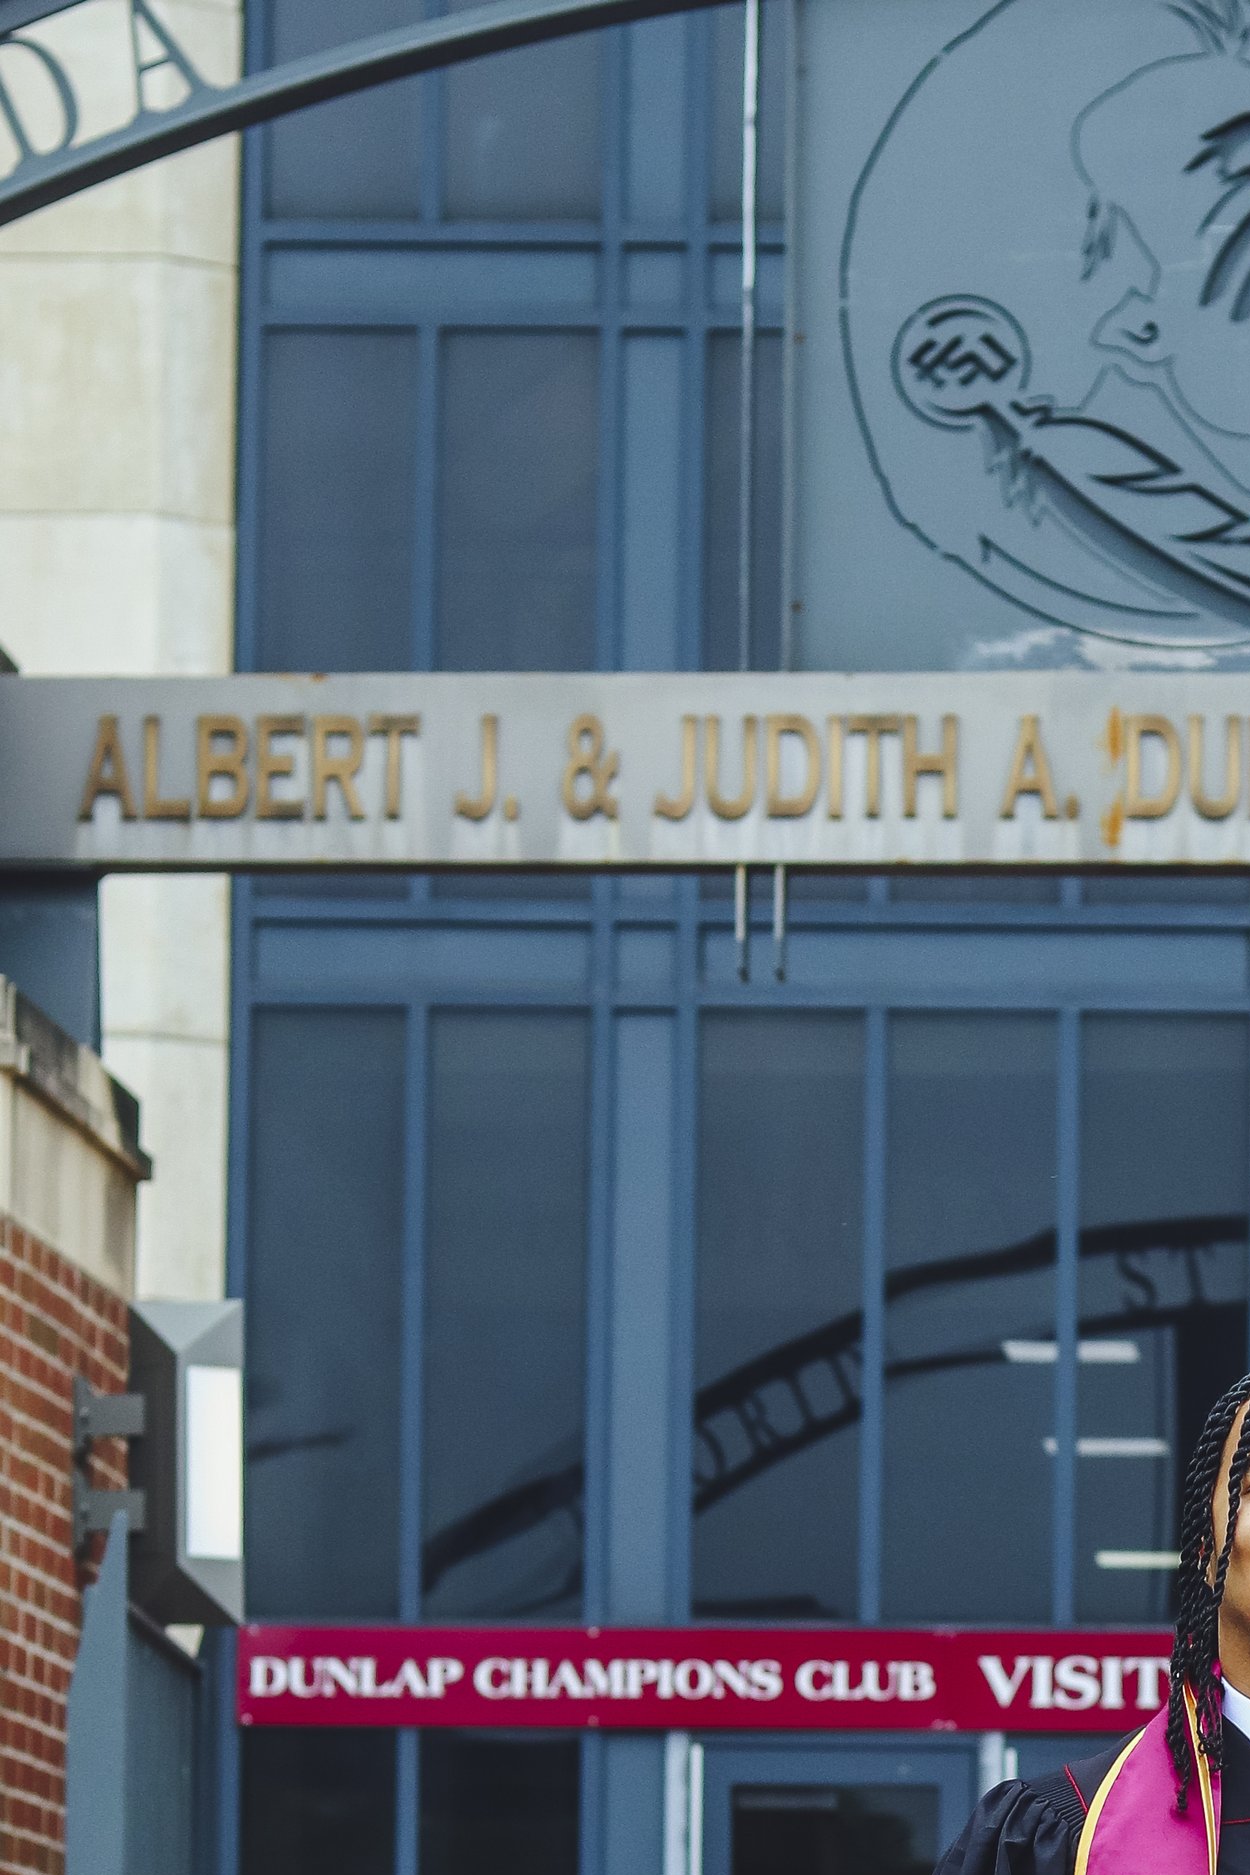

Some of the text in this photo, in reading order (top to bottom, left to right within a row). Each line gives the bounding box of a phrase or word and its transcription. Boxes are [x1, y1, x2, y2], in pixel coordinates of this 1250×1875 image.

[78, 713, 420, 822] ALBERT
[454, 713, 519, 822] J.
[562, 713, 619, 822] &
[652, 713, 958, 822] JUDITH
[1000, 713, 1080, 820] A.
[250, 1655, 937, 1702] DUNLAP CHAMPIONS CLUB
